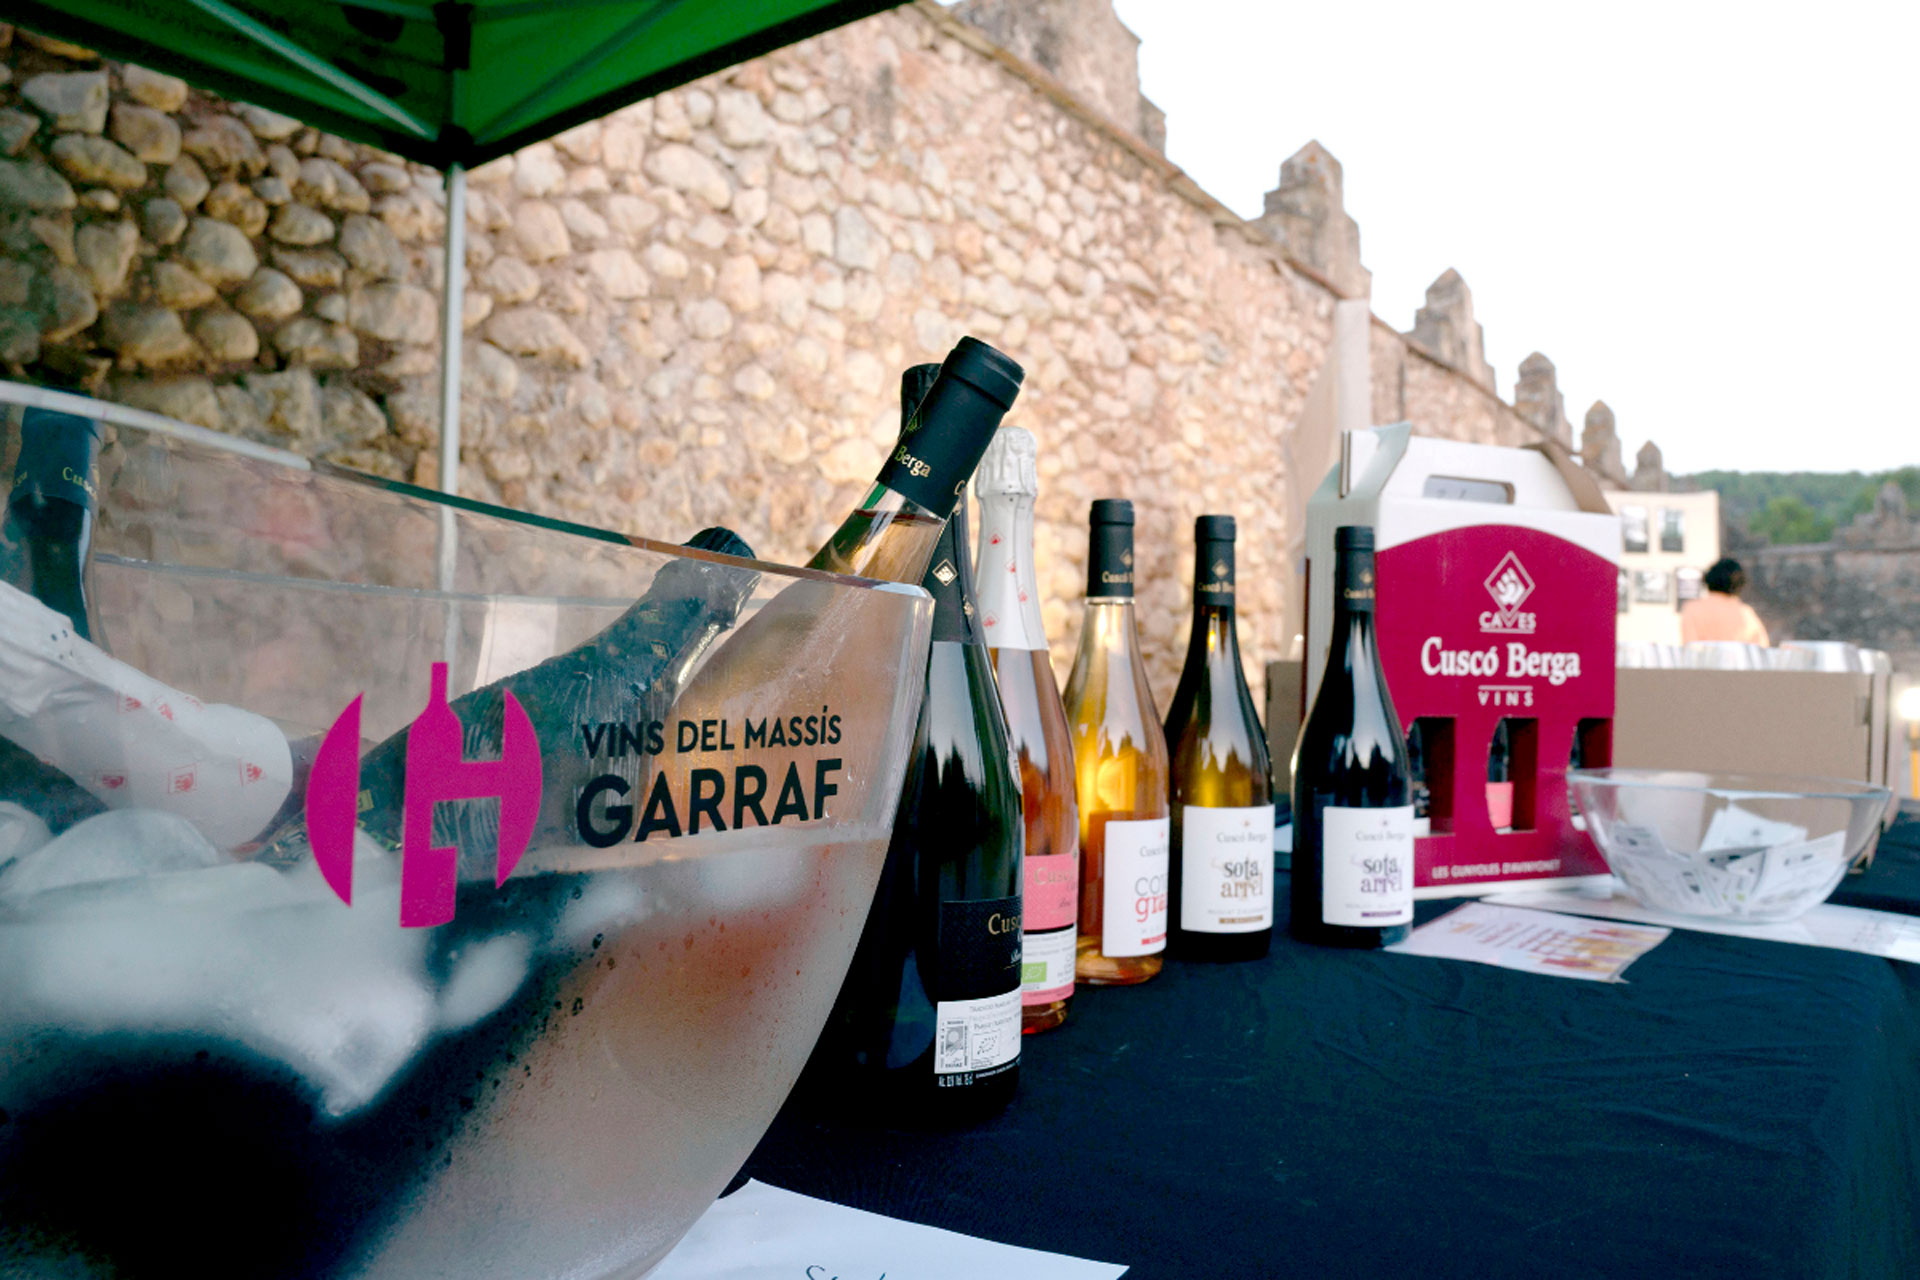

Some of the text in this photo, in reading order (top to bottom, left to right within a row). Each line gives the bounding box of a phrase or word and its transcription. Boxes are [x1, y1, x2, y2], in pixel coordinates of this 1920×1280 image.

[895, 445, 932, 478] Berga
[1479, 610, 1537, 629] CAVES
[1420, 636, 1581, 686] Cuscó Berga
[1478, 691, 1534, 707] VINS
[581, 704, 842, 759] VINS DEL MASSÍS
[576, 757, 843, 848] GARRAF
[1223, 853, 1260, 881] sota
[1362, 852, 1399, 877] sota
